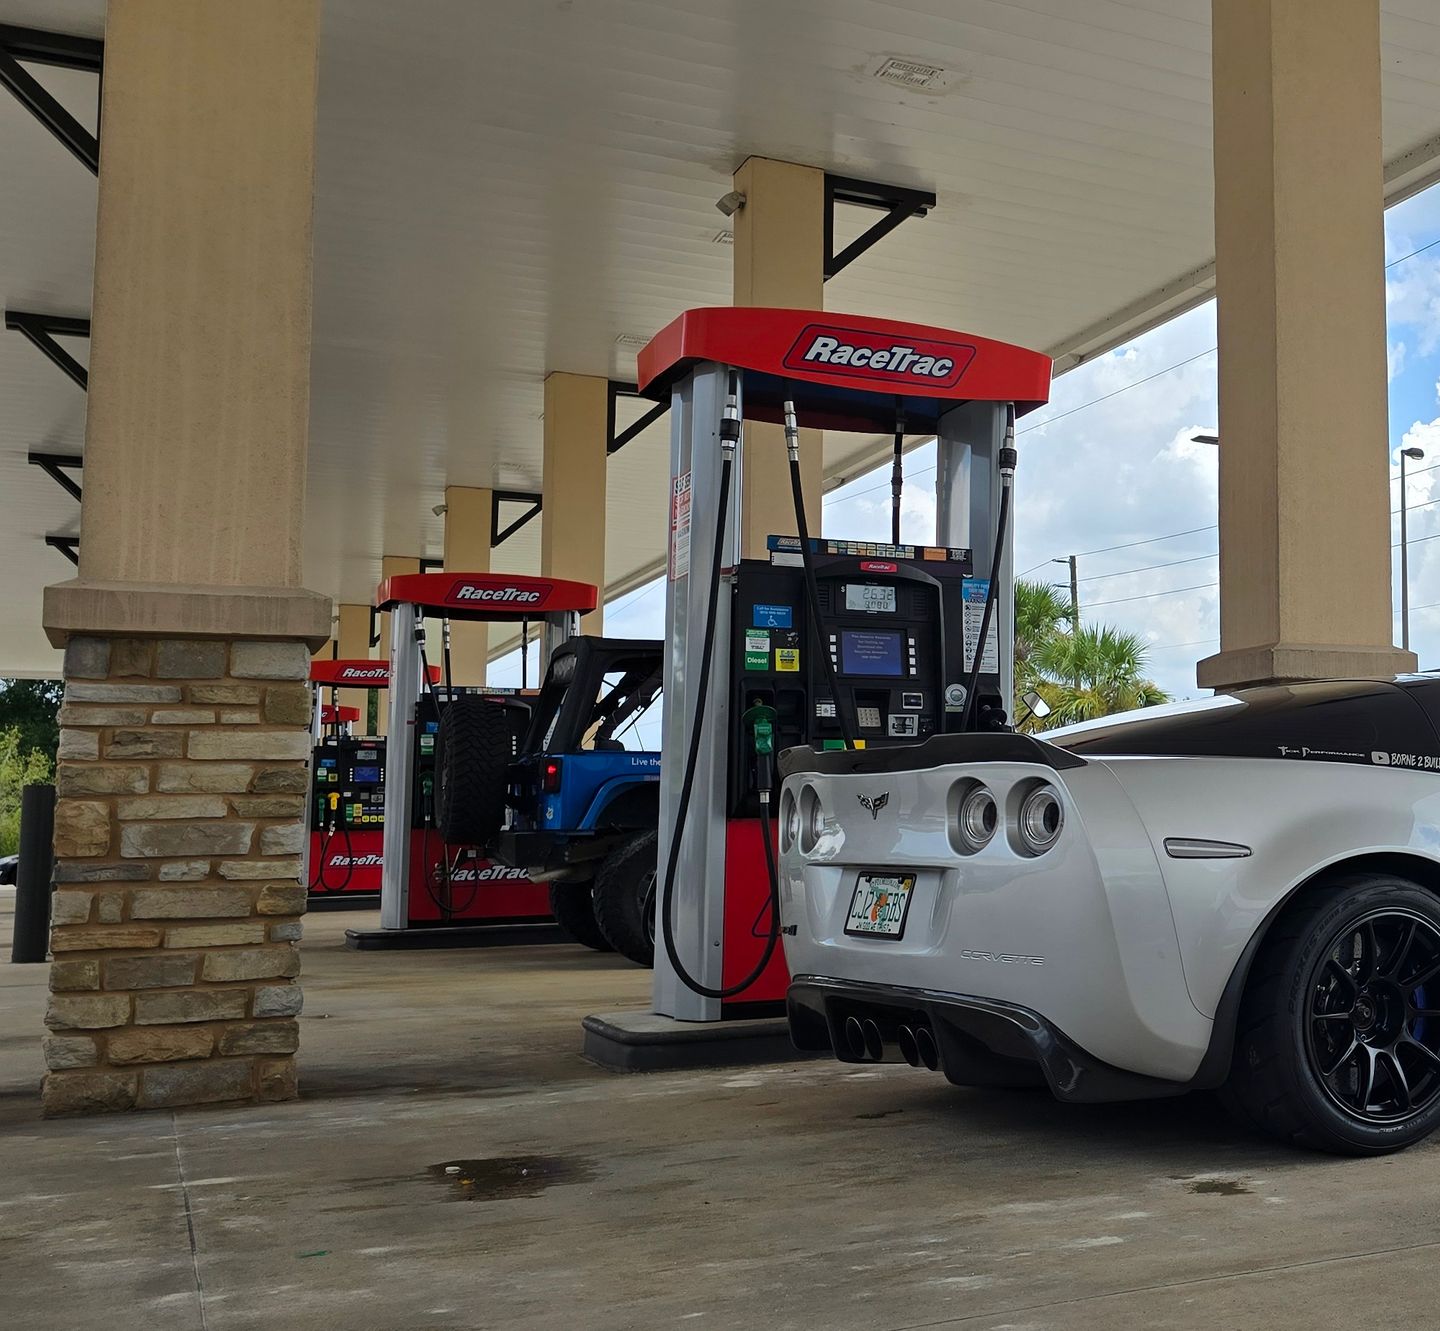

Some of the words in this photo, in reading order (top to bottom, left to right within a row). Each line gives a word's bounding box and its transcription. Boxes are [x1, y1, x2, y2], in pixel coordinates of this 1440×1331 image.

[805, 336, 953, 377] RaceTrac
[456, 585, 540, 602] RaceTrac
[342, 668, 389, 679] RaceTra
[631, 757, 647, 766] Live
[1391, 753, 1416, 766] BORNE
[1417, 756, 1423, 767] 2
[329, 855, 384, 866] RaceTra
[960, 949, 1045, 966] CORVETTE
